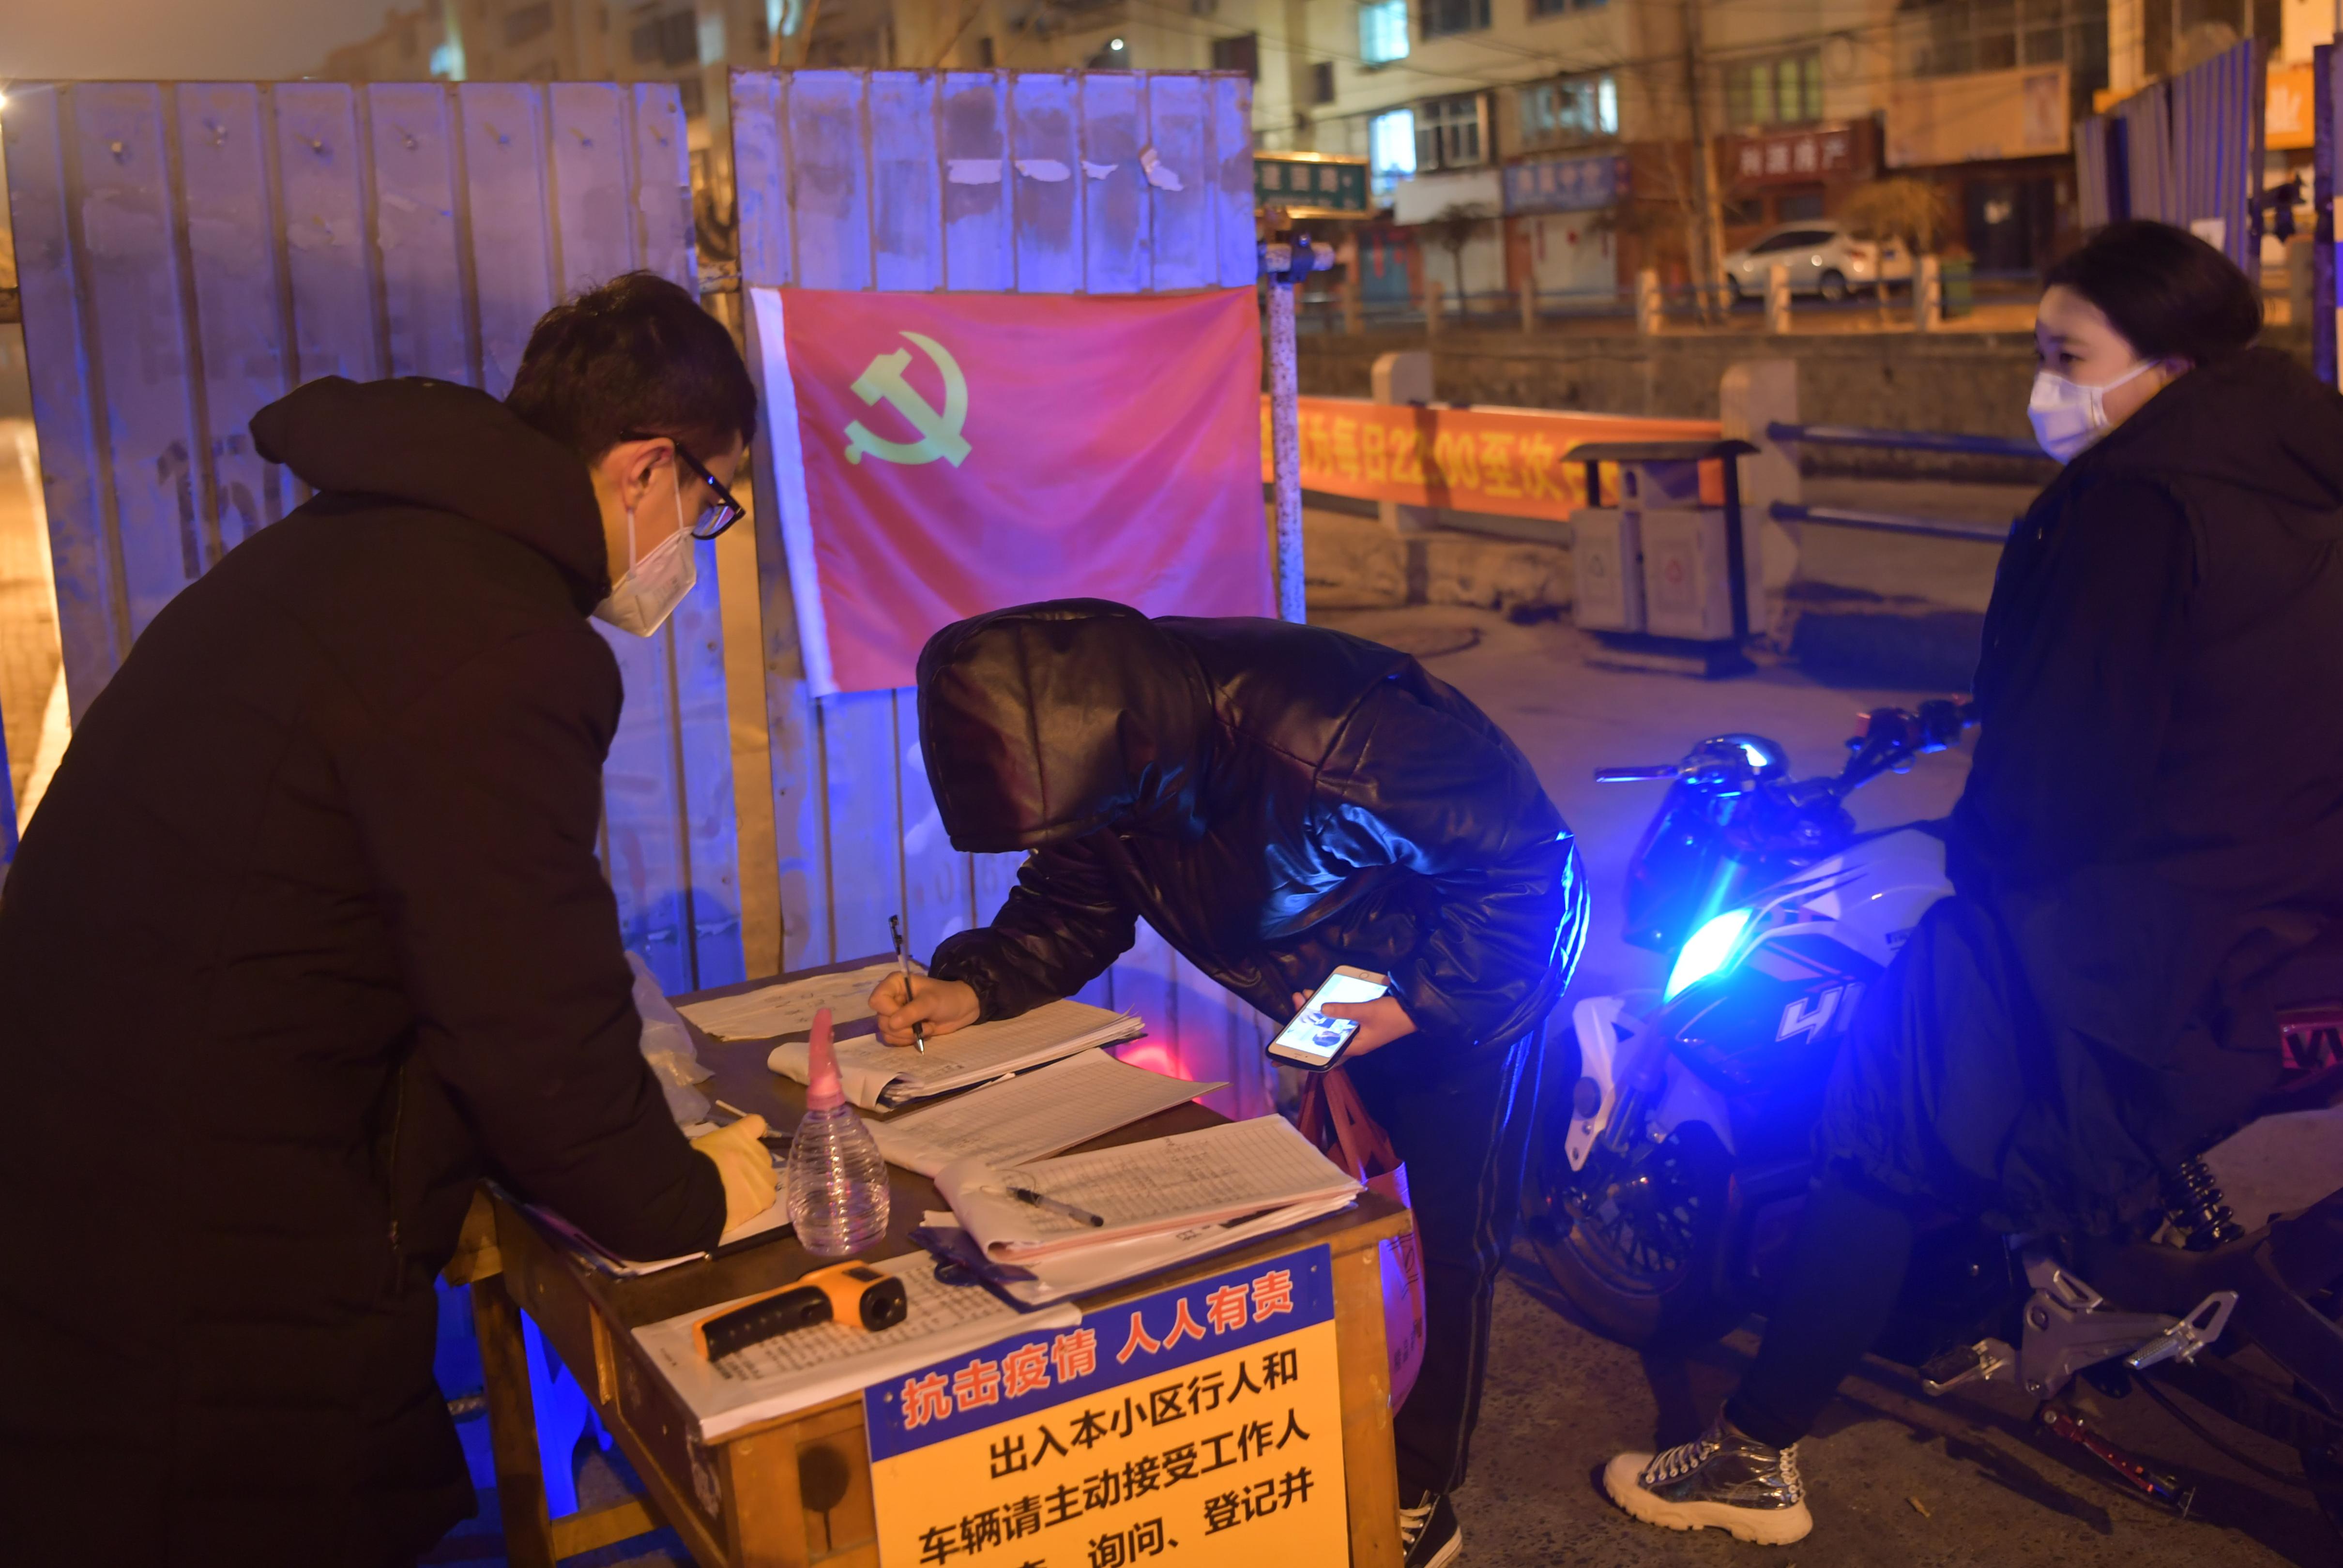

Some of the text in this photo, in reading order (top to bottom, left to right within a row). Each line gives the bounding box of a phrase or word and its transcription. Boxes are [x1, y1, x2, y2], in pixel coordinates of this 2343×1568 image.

[901, 1327, 1097, 1430] 抗击疫情
[1115, 1269, 1294, 1364] 人人有责
[989, 1348, 1299, 1481] 出入本小区行人和
[918, 1408, 1310, 1567] 车辆请主动接受工作人
[1017, 1466, 1315, 1568] 询问、登记并
